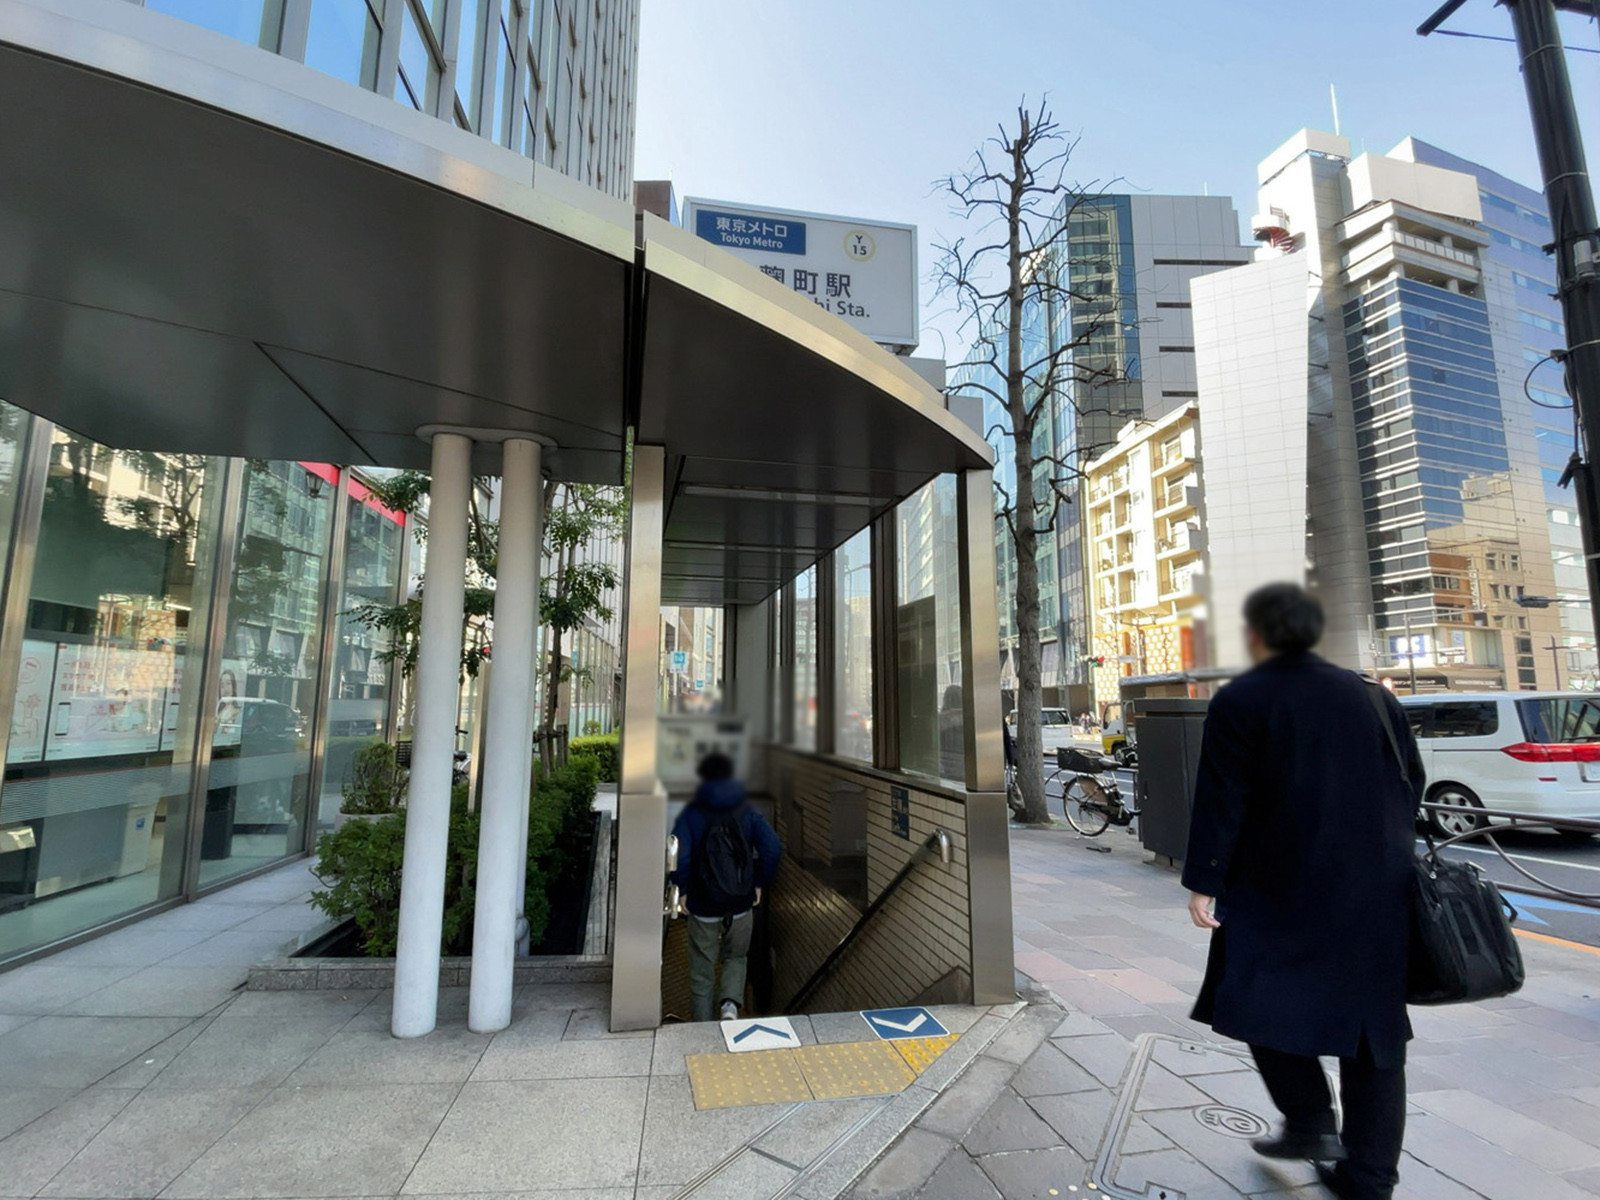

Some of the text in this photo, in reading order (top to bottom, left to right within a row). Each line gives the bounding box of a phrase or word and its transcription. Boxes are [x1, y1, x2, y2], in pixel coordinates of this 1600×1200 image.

[716, 217, 788, 238] 東京メトロ
[720, 232, 783, 249] Tokyo Metro
[855, 235, 863, 244] Y
[853, 245, 867, 255] 15
[837, 300, 870, 318] Sta.
